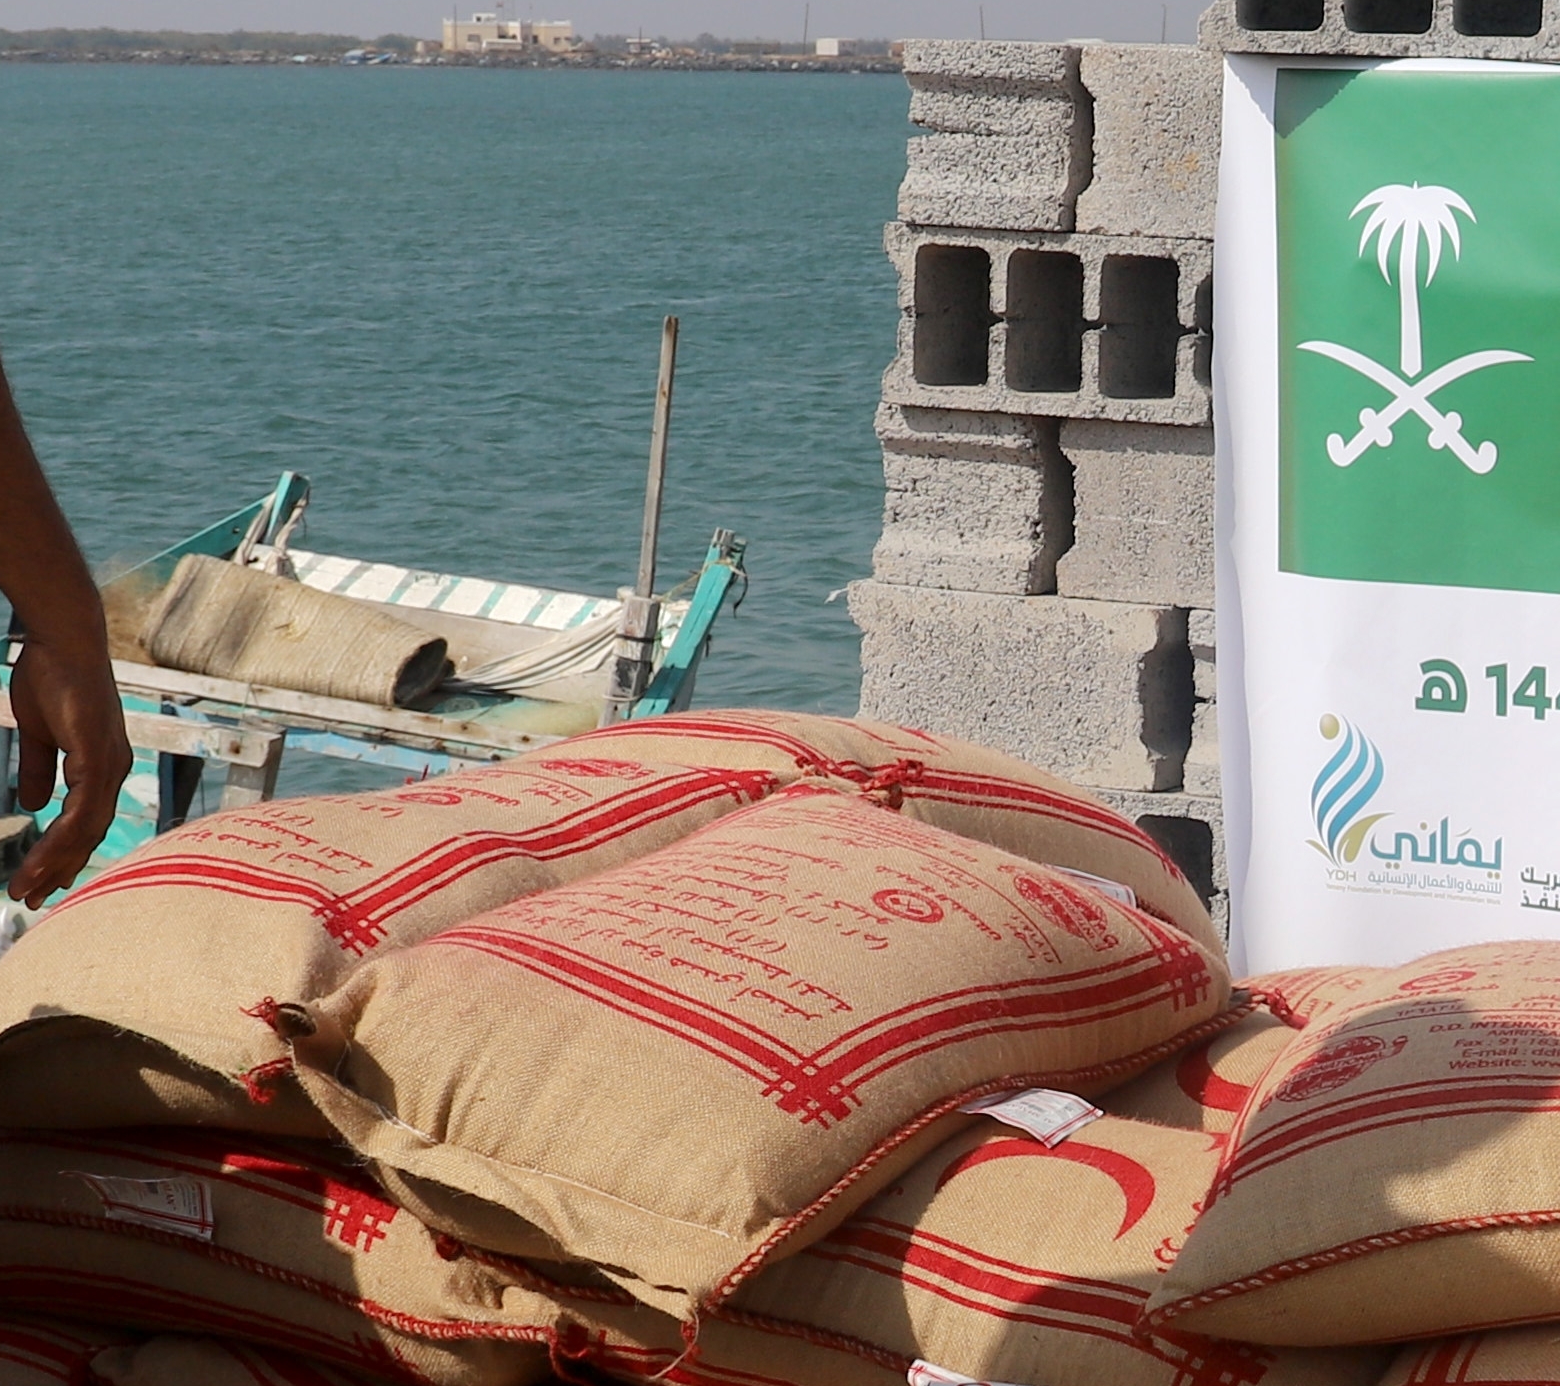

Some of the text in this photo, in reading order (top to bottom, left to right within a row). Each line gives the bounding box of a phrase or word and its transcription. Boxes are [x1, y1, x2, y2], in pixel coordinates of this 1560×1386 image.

[1325, 867, 1357, 882] YDH
[621, 939, 665, 959] مزة
[669, 956, 745, 983] هندي
[729, 986, 823, 1021] أصفر
[690, 936, 791, 980] متوسط
[788, 980, 853, 1013] الحبة
[1428, 1021, 1465, 1035] D.D.
[1460, 1045, 1518, 1059] E-mail
[1447, 1056, 1527, 1071] Website:
